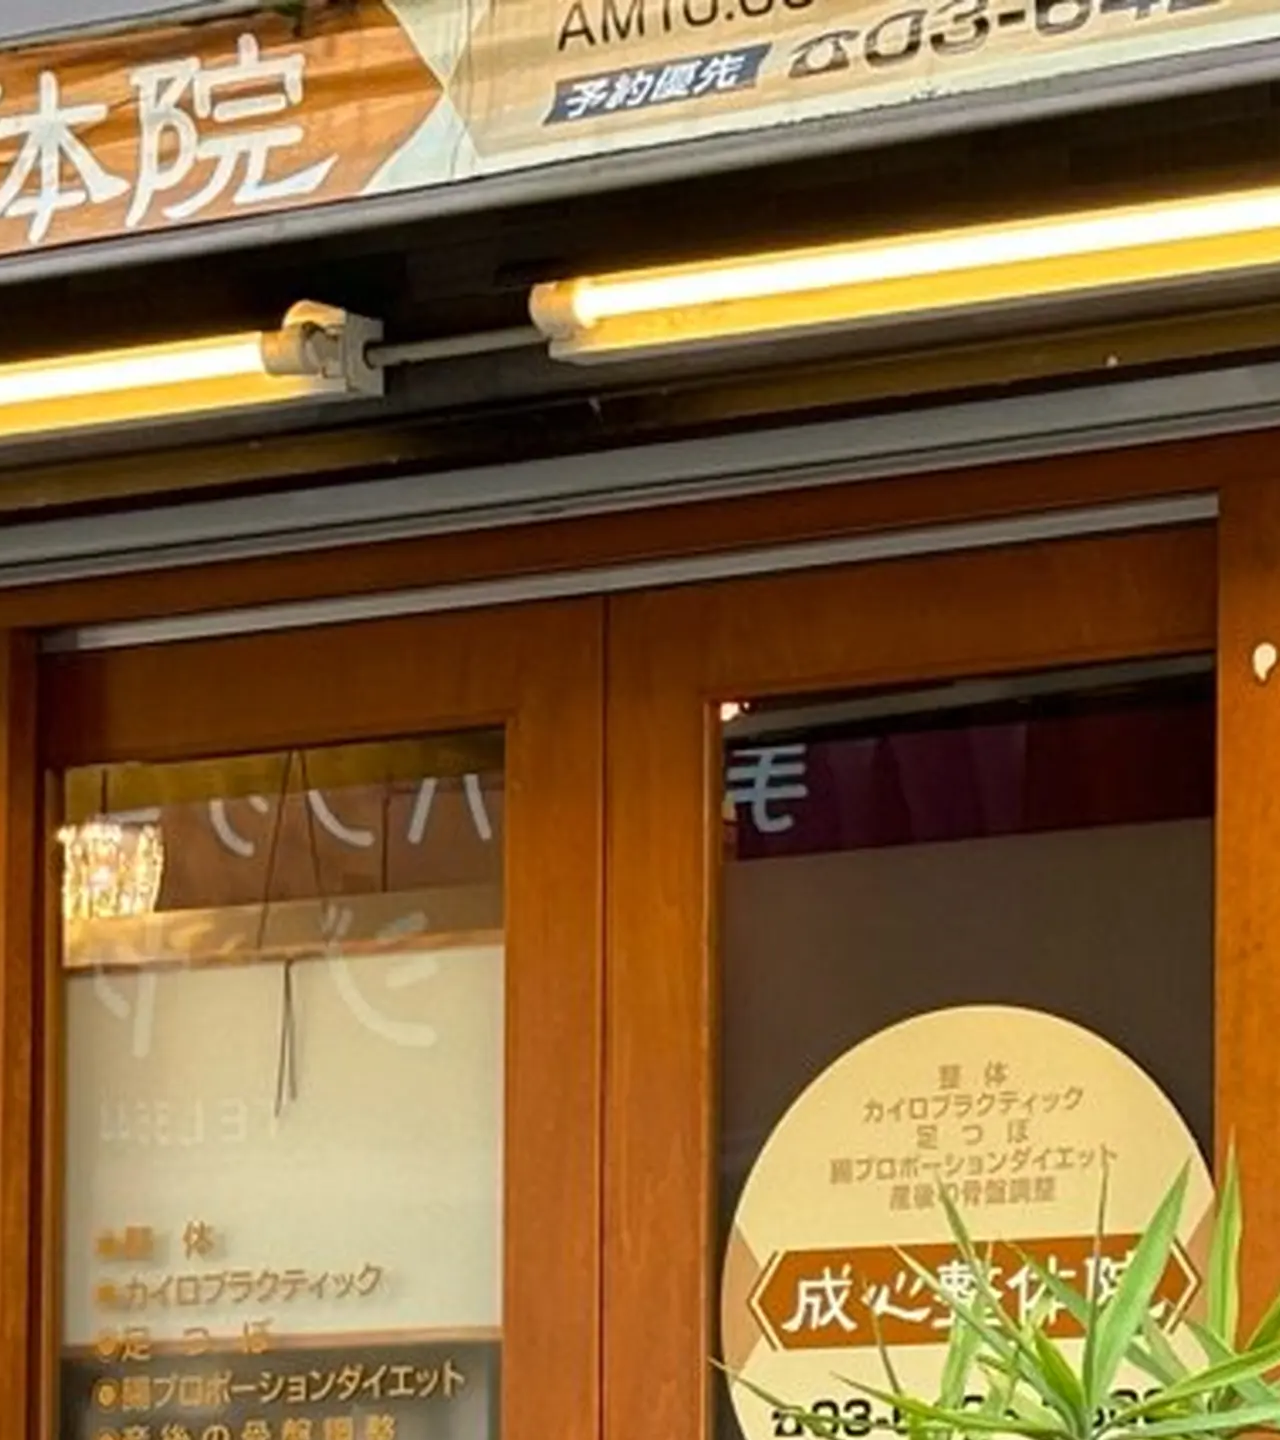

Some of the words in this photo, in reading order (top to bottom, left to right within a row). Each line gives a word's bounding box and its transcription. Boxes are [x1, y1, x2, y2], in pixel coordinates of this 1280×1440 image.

[566, 54, 746, 118] 予約優先
[937, 1060, 1009, 1090] 整体
[862, 1085, 1084, 1124] カイロプラクティック
[916, 1118, 1031, 1150] 足つぼ
[889, 1176, 1057, 1212] 産後の骨盤調整
[123, 1262, 384, 1312] カイロプラクティック
